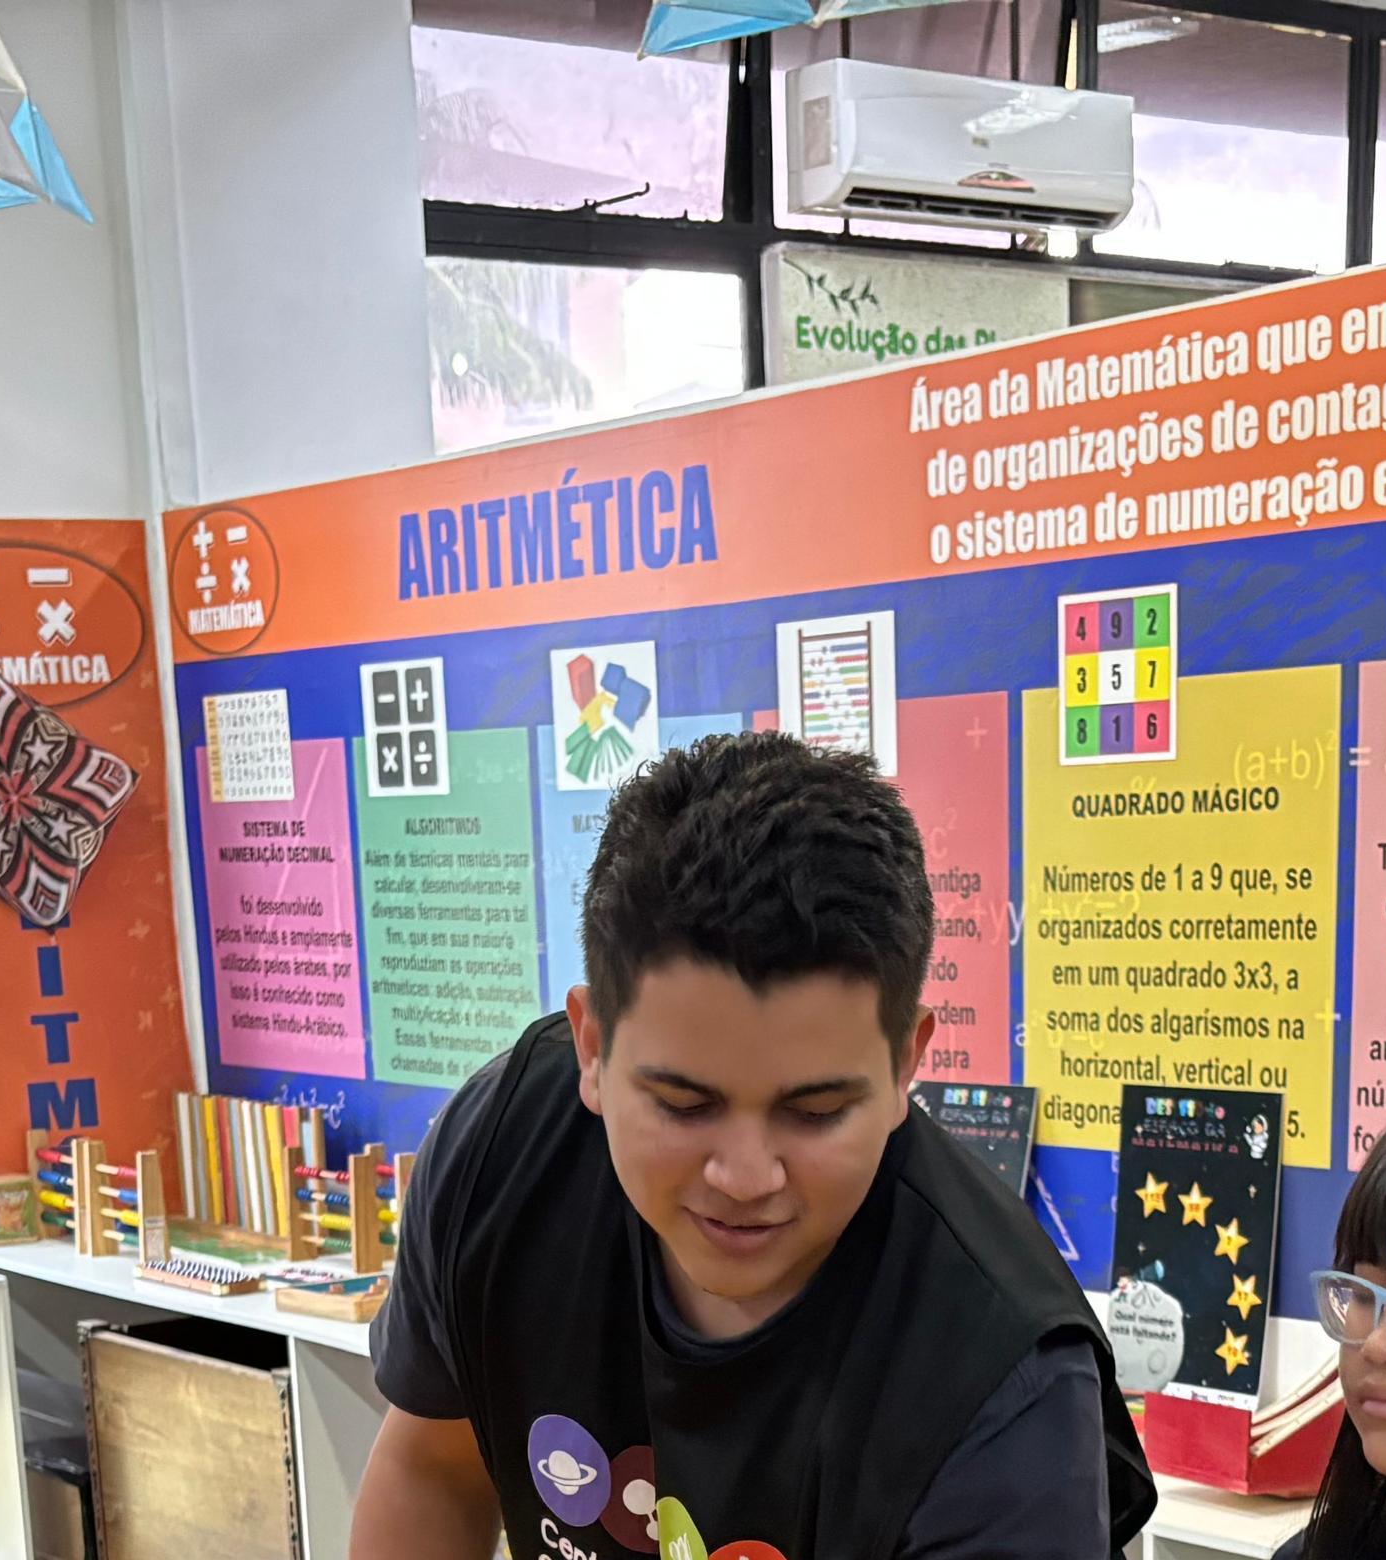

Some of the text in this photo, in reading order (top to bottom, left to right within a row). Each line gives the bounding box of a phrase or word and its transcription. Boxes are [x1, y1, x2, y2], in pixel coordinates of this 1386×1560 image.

[796, 315, 916, 360] Evolução
[911, 378, 981, 434] Área
[989, 368, 1028, 418] da
[1037, 335, 1248, 415] Matemática
[1257, 319, 1332, 381] que
[927, 448, 965, 498] de
[974, 410, 1202, 490] organizações
[1212, 398, 1258, 455] de
[930, 522, 949, 564] o
[957, 500, 1087, 560] sistema
[1094, 492, 1138, 542] de
[1147, 459, 1363, 541] numeração
[398, 463, 718, 602] ARITMÉTICA
[188, 600, 264, 635] MATEMÁTICA
[1075, 610, 1157, 641] 4 9 2
[1075, 660, 1158, 693] 3 5 7
[1075, 714, 1157, 745] 8 1 6
[1073, 784, 1279, 818] QUADRADO MÁGICO
[292, 821, 305, 836] DE
[1039, 913, 1317, 945] organizados corretamente
[1047, 1010, 1100, 1031] soma
[1108, 1007, 1144, 1033] dos
[1279, 1018, 1304, 1040] na
[1061, 1052, 1287, 1088] horizontal, vertical ou
